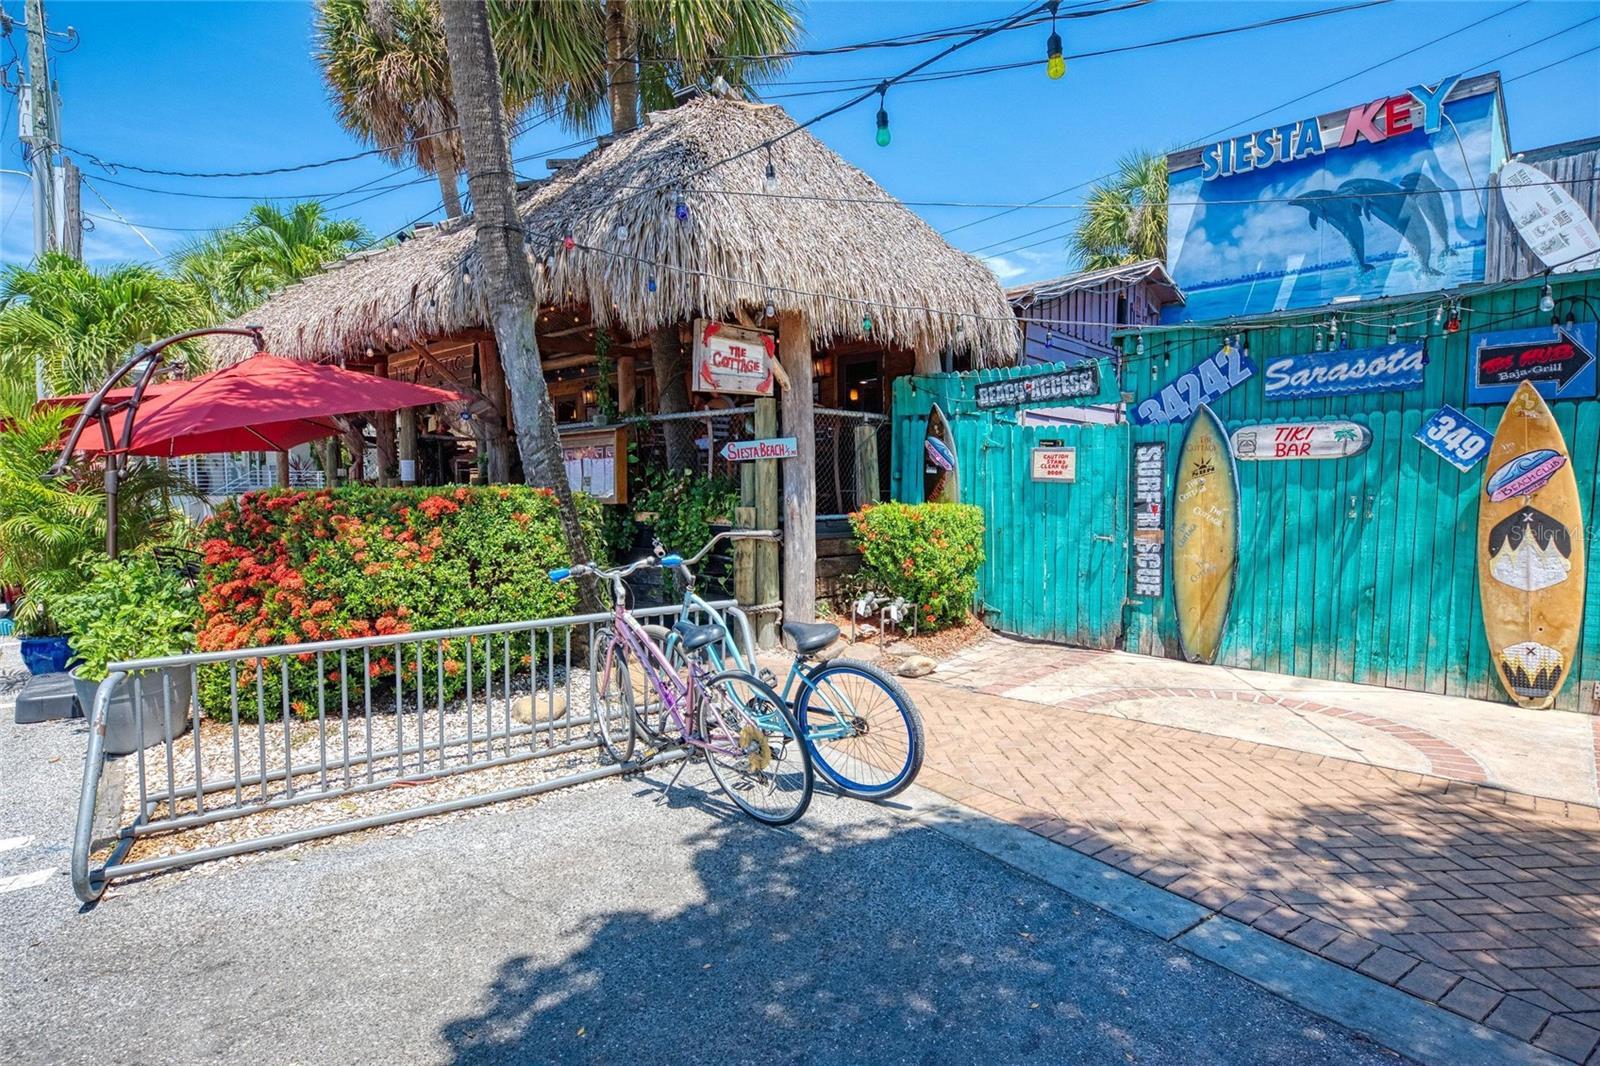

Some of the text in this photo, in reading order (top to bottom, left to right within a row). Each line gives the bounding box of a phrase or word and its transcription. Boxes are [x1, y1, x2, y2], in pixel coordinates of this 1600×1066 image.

[1200, 74, 1462, 181] SIESTA KEY
[713, 351, 760, 373] COTTAGE
[729, 346, 747, 358] THE
[1264, 348, 1424, 391] Sarasota
[979, 371, 1092, 403] BEACH ACCESS
[1138, 346, 1252, 425] 34242
[727, 443, 759, 459] SIESTA
[760, 442, 785, 457] BEACH
[1274, 427, 1315, 441] TIKI
[1275, 443, 1311, 457] BAR
[1427, 415, 1486, 460] 349
[1500, 473, 1536, 497] BEACH
[1535, 459, 1561, 477] CLUB
[1136, 446, 1162, 596] SURF RSCUE
